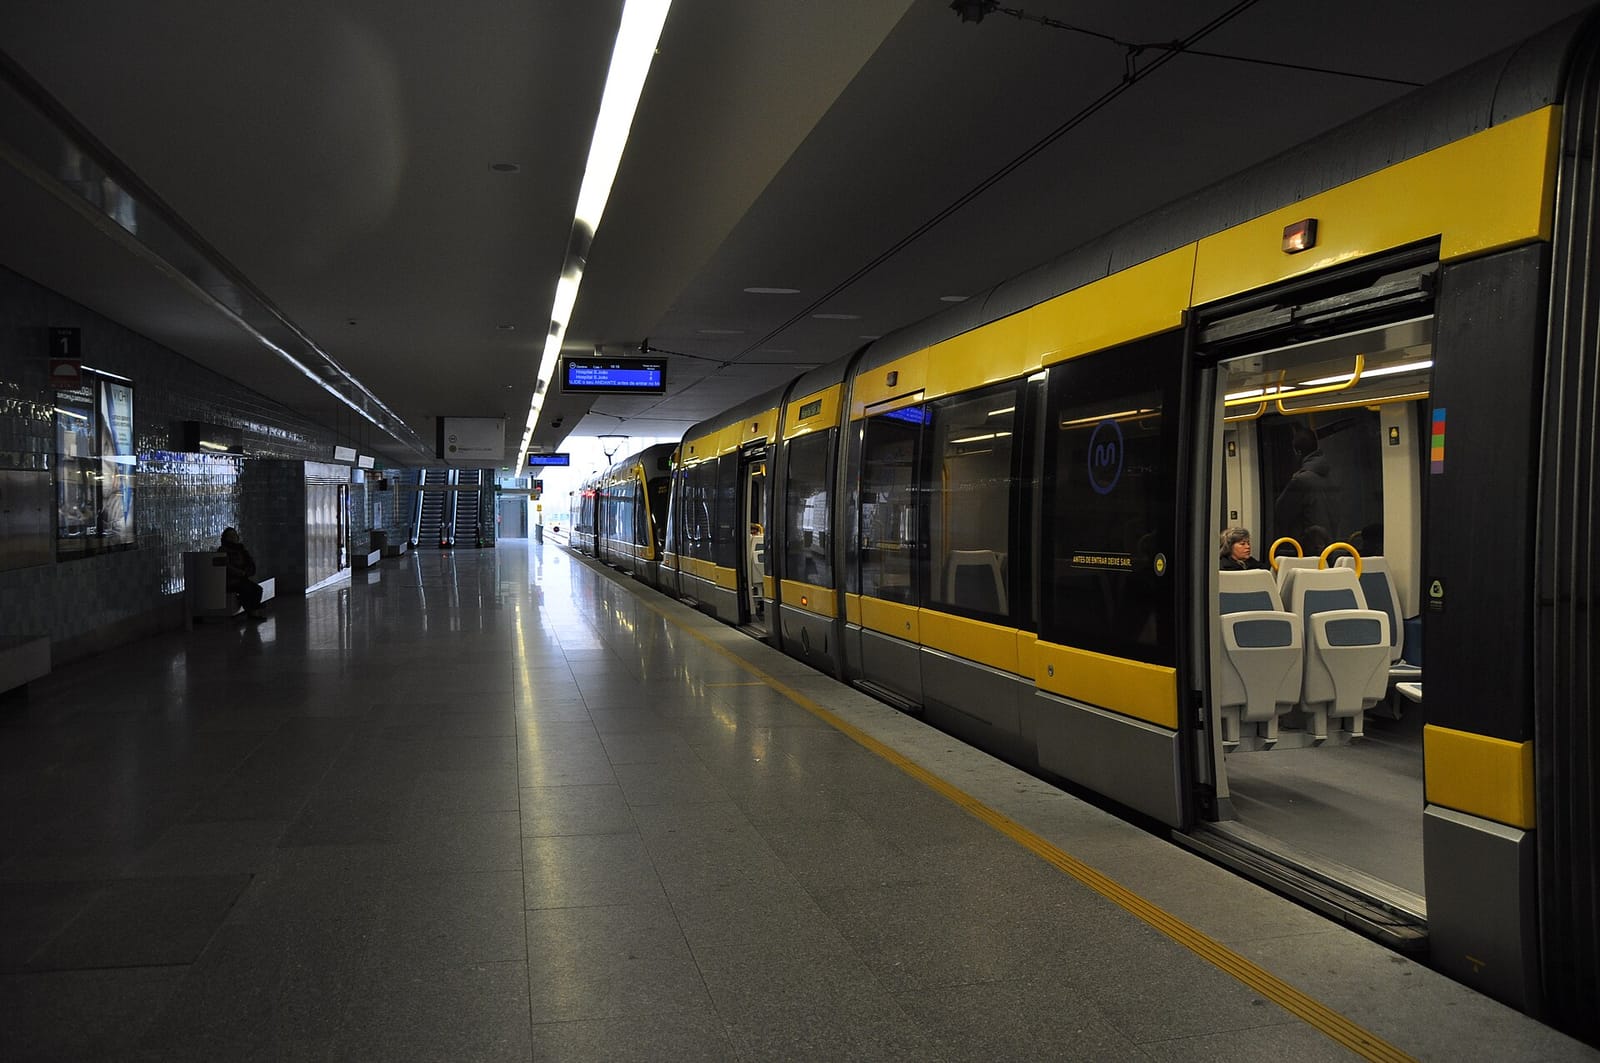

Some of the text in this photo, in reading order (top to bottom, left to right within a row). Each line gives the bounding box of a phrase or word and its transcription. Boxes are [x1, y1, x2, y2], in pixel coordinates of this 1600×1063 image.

[60, 336, 68, 354] 1
[1073, 555, 1085, 564] ANTES
[1085, 556, 1091, 564] DE
[1091, 556, 1107, 565] ENTRAR
[1107, 557, 1120, 566] DEIXE
